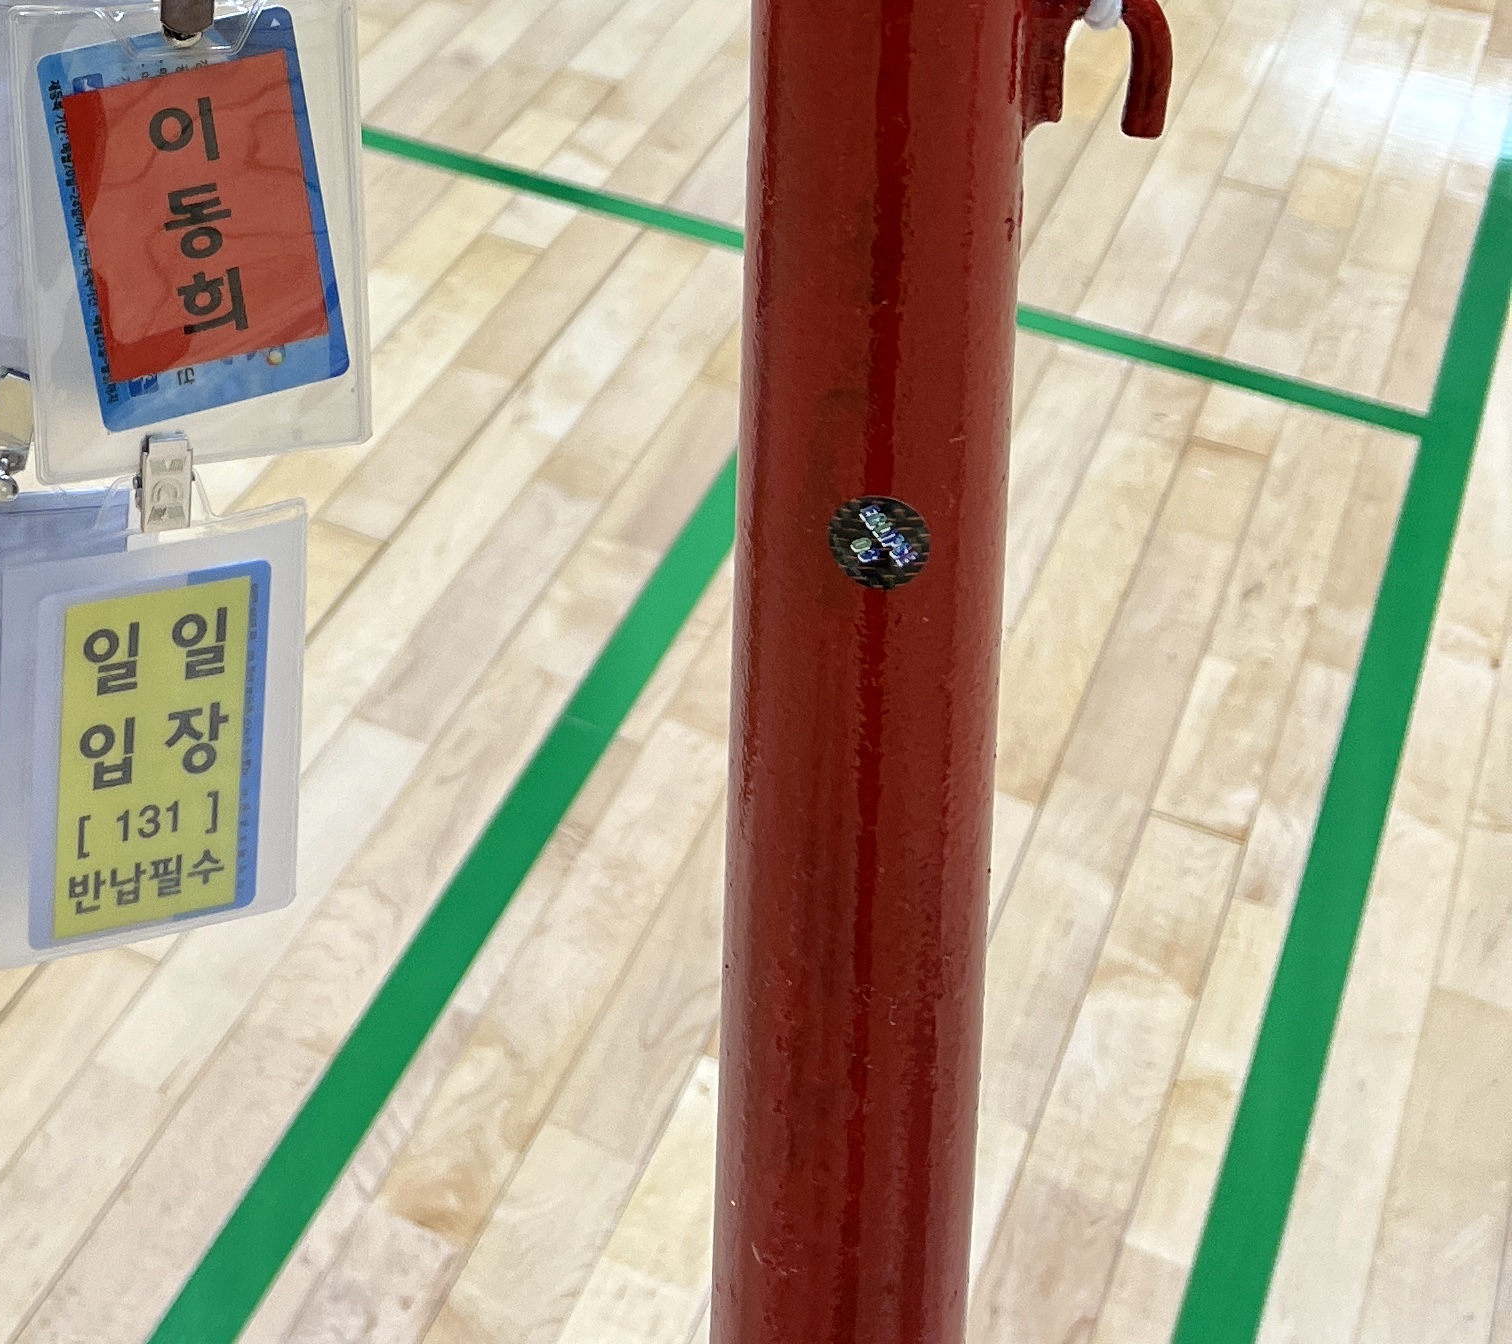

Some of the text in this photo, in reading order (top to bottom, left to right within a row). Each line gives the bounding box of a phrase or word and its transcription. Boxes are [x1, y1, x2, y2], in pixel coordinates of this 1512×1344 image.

[859, 505, 918, 567] ECLIPSE
[84, 607, 227, 696] 일 일
[80, 702, 228, 790] 입 장
[116, 801, 180, 843] 131
[69, 849, 225, 914] 반납필수
